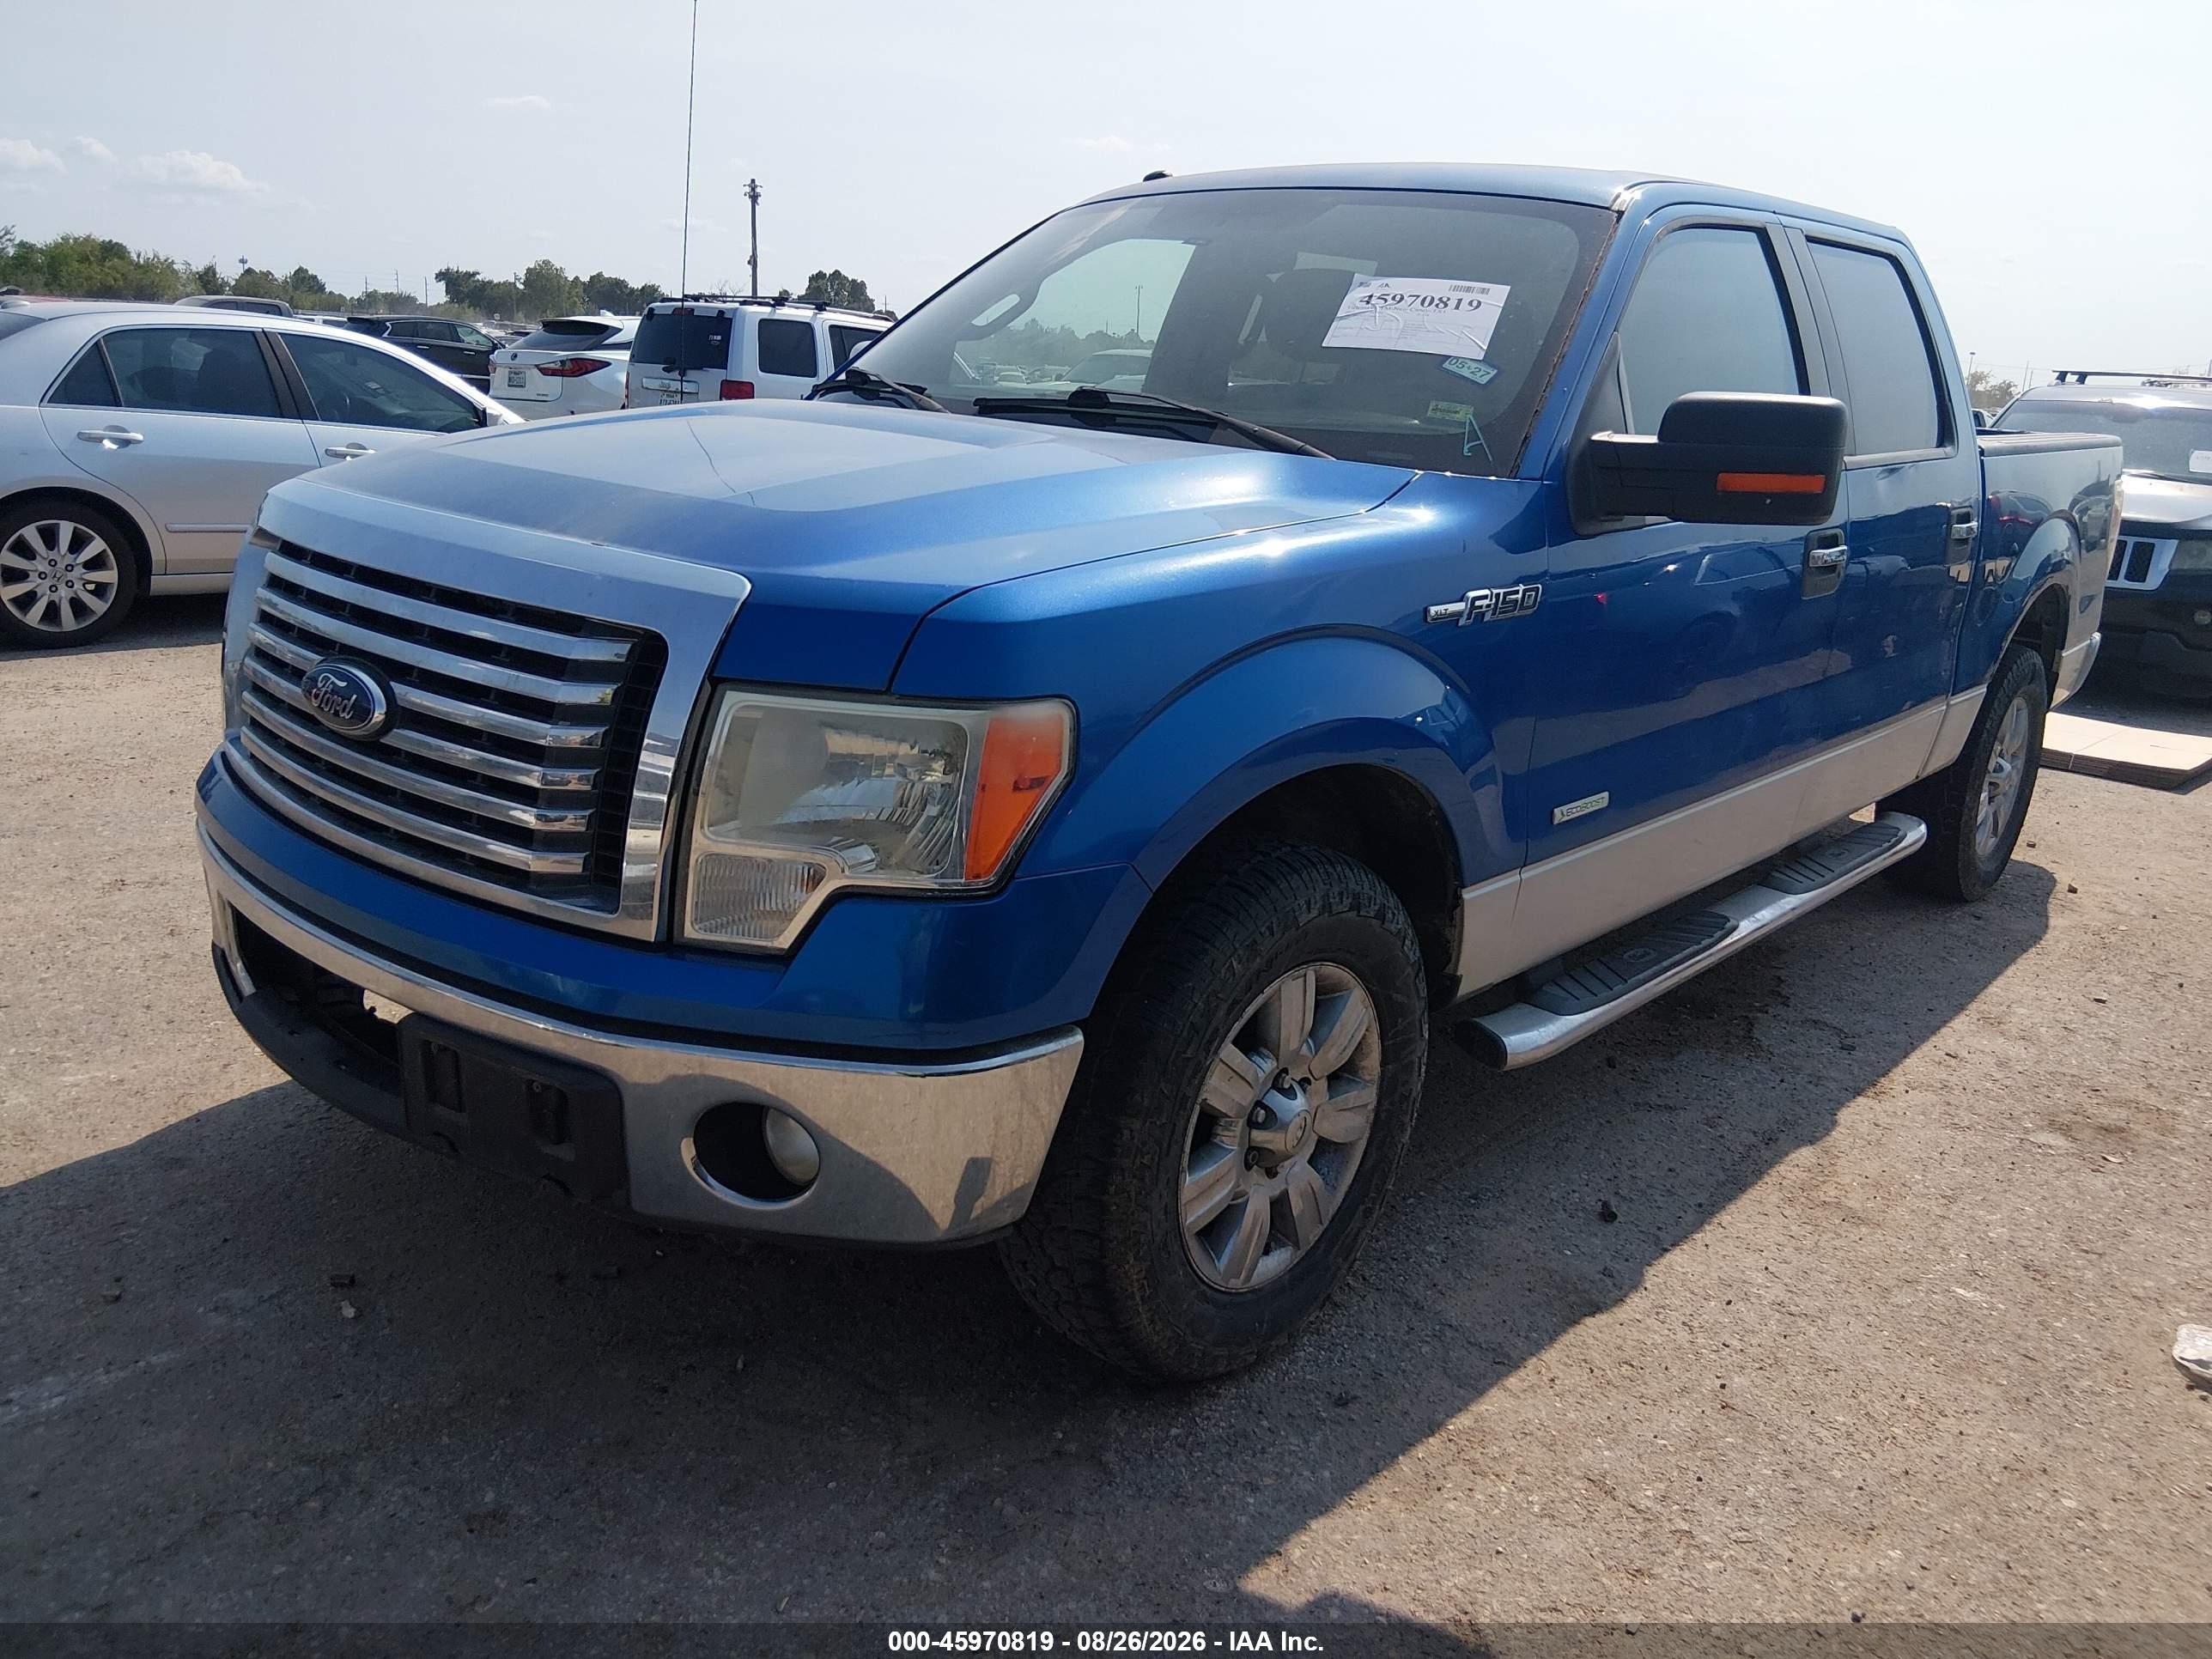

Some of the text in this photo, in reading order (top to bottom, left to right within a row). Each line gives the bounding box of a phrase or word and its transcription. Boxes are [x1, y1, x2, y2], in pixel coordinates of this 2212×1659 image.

[1358, 293, 1483, 313] 45970819
[1433, 608, 1449, 617] XLT
[311, 672, 357, 720] Ford
